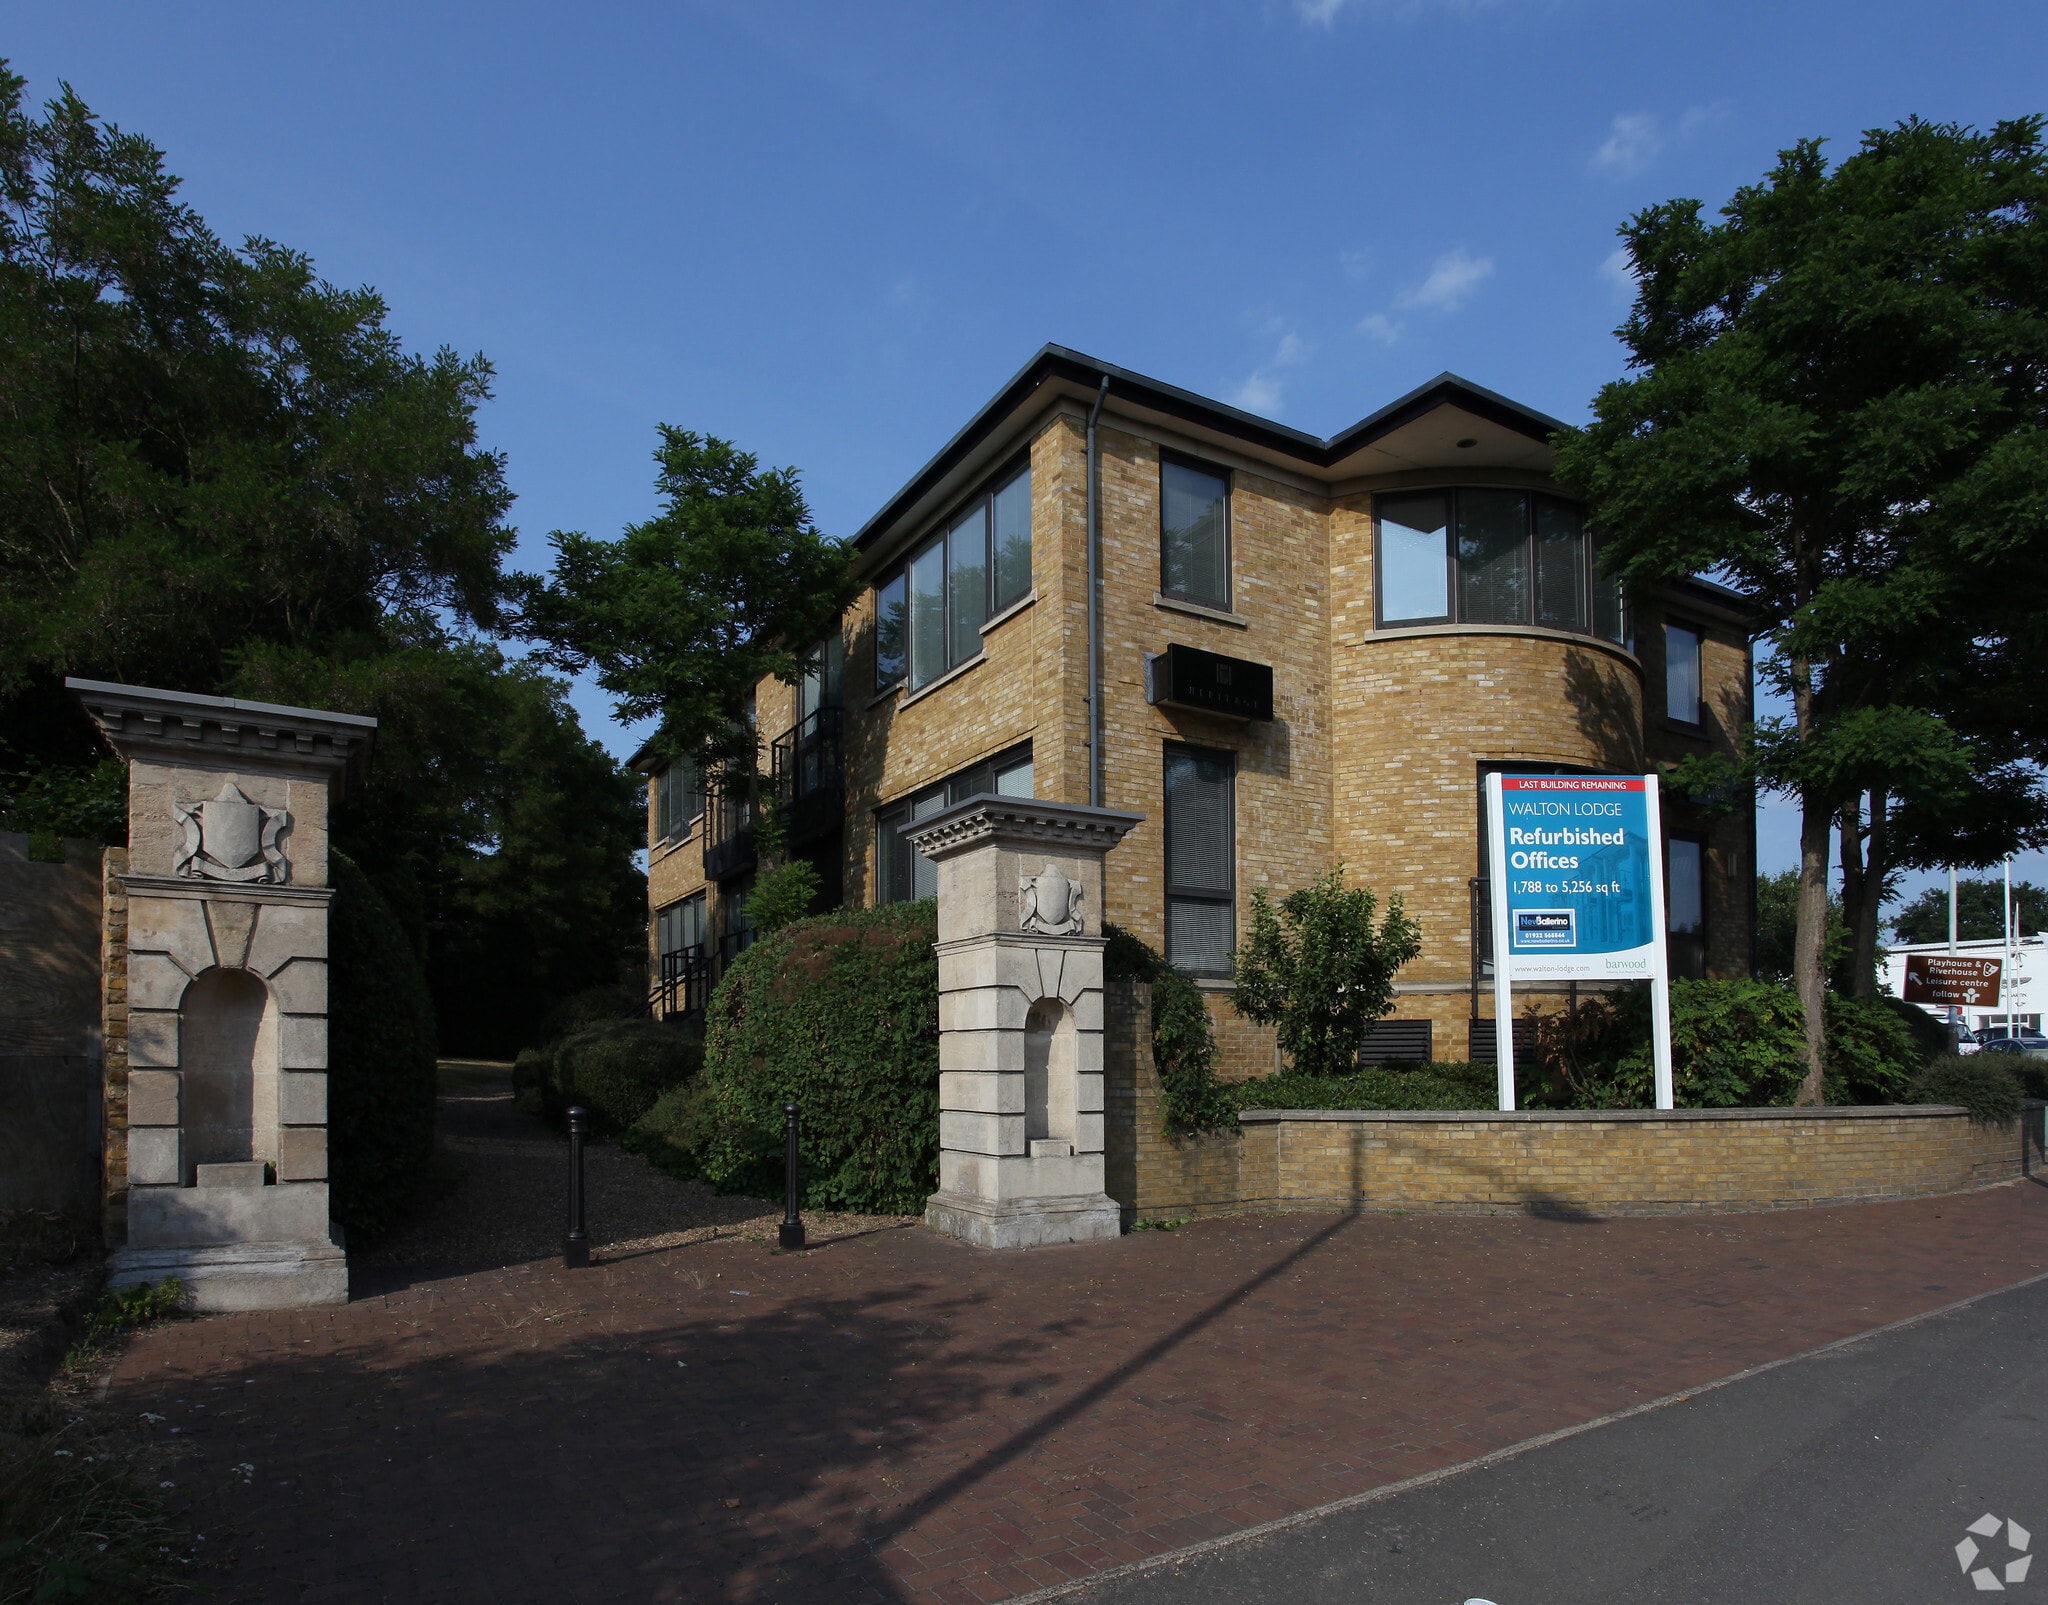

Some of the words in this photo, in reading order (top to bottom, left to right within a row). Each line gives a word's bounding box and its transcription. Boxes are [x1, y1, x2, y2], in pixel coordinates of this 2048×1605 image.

[1519, 781, 1539, 789] LAST
[1540, 781, 1579, 790] BUILDING
[1581, 781, 1626, 790] REMAINING
[1508, 802, 1570, 816] WALTON
[1574, 802, 1622, 817] LODGE
[1509, 827, 1625, 845] Refurbished
[1511, 851, 1579, 869] Offices
[1513, 881, 1542, 895] 1,788
[1545, 882, 1558, 893] to
[1561, 881, 1592, 895] 5,256
[1595, 884, 1608, 897] sq
[1611, 881, 1620, 893] ft
[1605, 958, 1647, 969] barwood
[1927, 958, 1973, 968] Playhouse
[1975, 960, 1982, 968] &
[1514, 964, 1590, 974] www.walton-lodge.com
[1929, 967, 1978, 977] Riverhouse
[1926, 977, 1958, 986] Leisure
[1959, 979, 1989, 988] centre
[1932, 989, 1960, 998] follow
